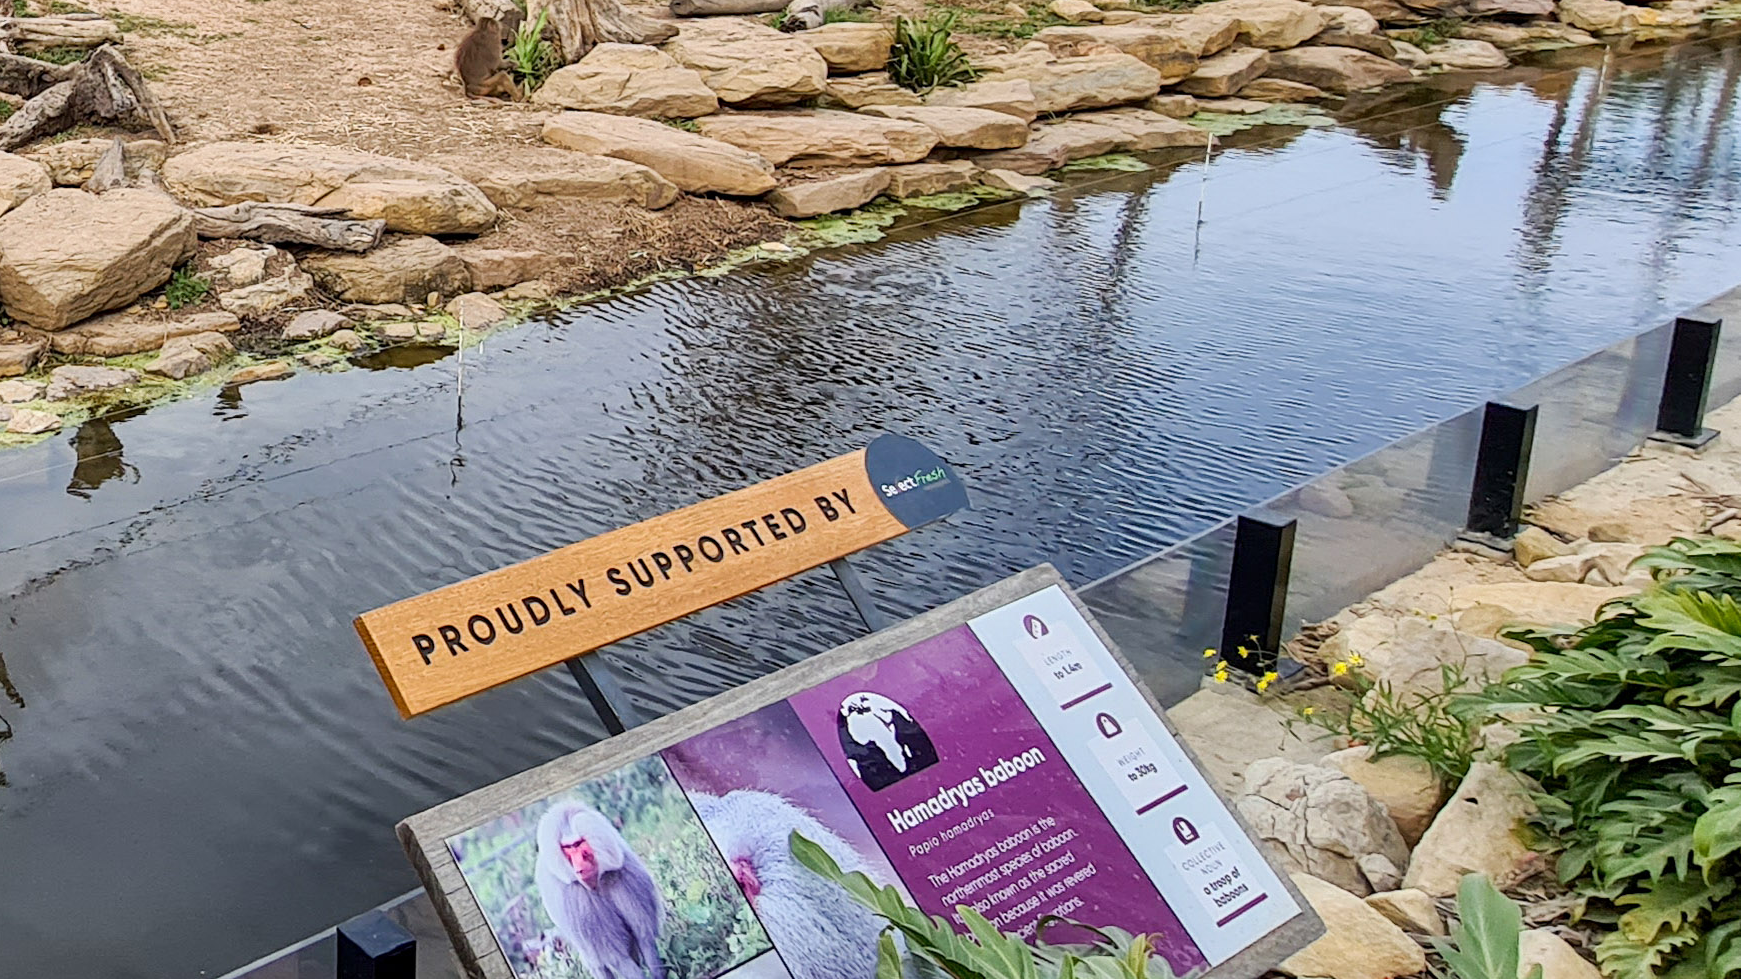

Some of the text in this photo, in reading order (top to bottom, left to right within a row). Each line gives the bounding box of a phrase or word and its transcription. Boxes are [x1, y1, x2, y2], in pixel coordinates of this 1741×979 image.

[411, 488, 857, 666] PROUDLY SUPPORTED BY
[1043, 649, 1073, 666] LENGTH
[1053, 670, 1065, 680] to
[1117, 747, 1147, 767] WEIGHT
[1127, 762, 1158, 782] to 30kg
[886, 746, 1047, 834] Hamadryas baboon
[908, 808, 995, 857] Papio hamadryas
[927, 816, 1056, 888] The Hamadryas baboon is the
[941, 828, 1079, 907] northernmost species of baboon.
[1181, 841, 1226, 871] COLLECTIVE
[1200, 858, 1223, 875] NOUN
[987, 883, 1020, 906] known
[1017, 876, 1032, 890] as
[1028, 868, 1046, 884] the
[1044, 849, 1076, 875] sacred
[998, 896, 1041, 923] because
[1036, 890, 1049, 902] it
[1045, 881, 1066, 898] was
[1063, 861, 1097, 888] revered
[1203, 865, 1241, 896] a troop of
[1213, 883, 1249, 908] baboons
